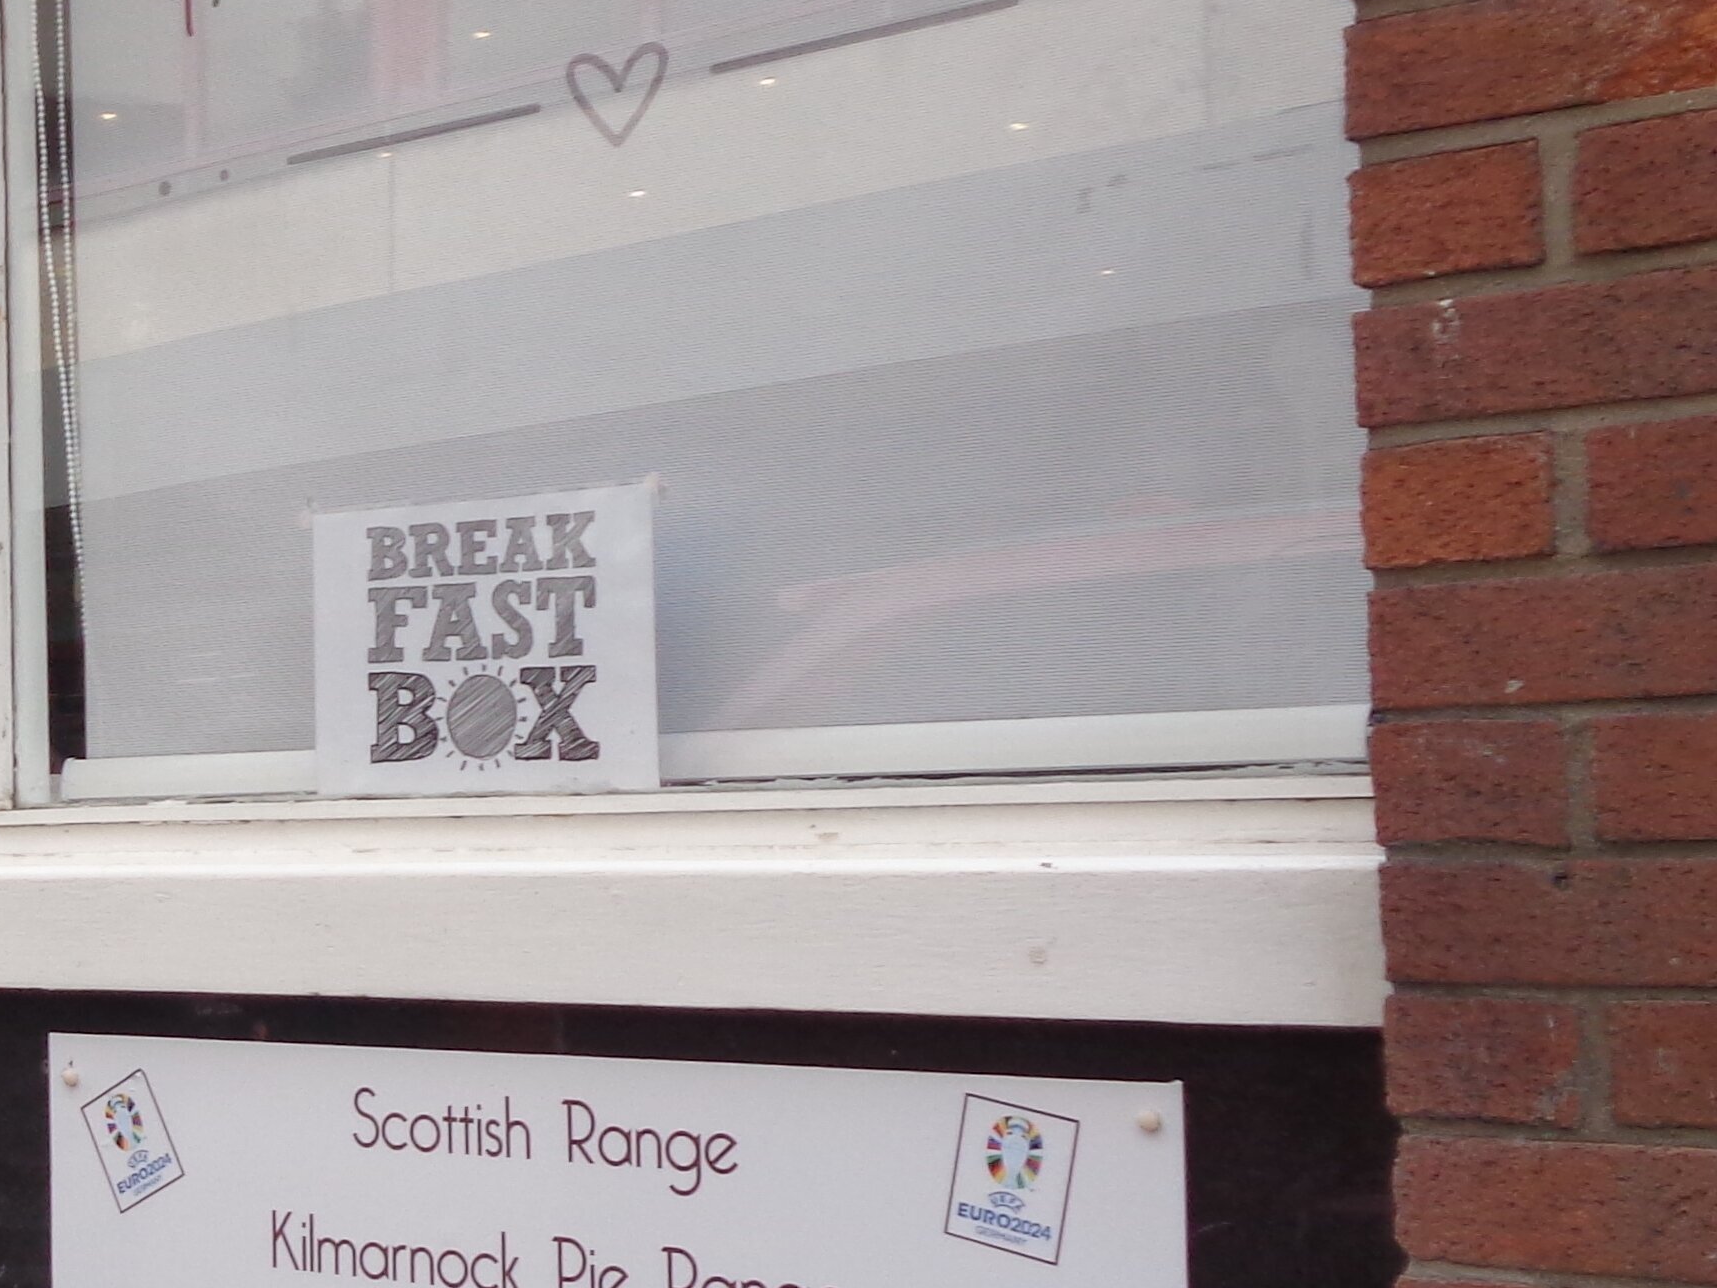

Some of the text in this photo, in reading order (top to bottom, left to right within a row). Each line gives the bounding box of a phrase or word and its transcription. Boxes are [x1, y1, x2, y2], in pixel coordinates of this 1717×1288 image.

[367, 511, 597, 581] BREAK
[367, 576, 597, 663] FAST
[368, 665, 600, 764] BOX
[351, 1086, 740, 1196] Scottish Range
[957, 1202, 1052, 1241] EURO2024
